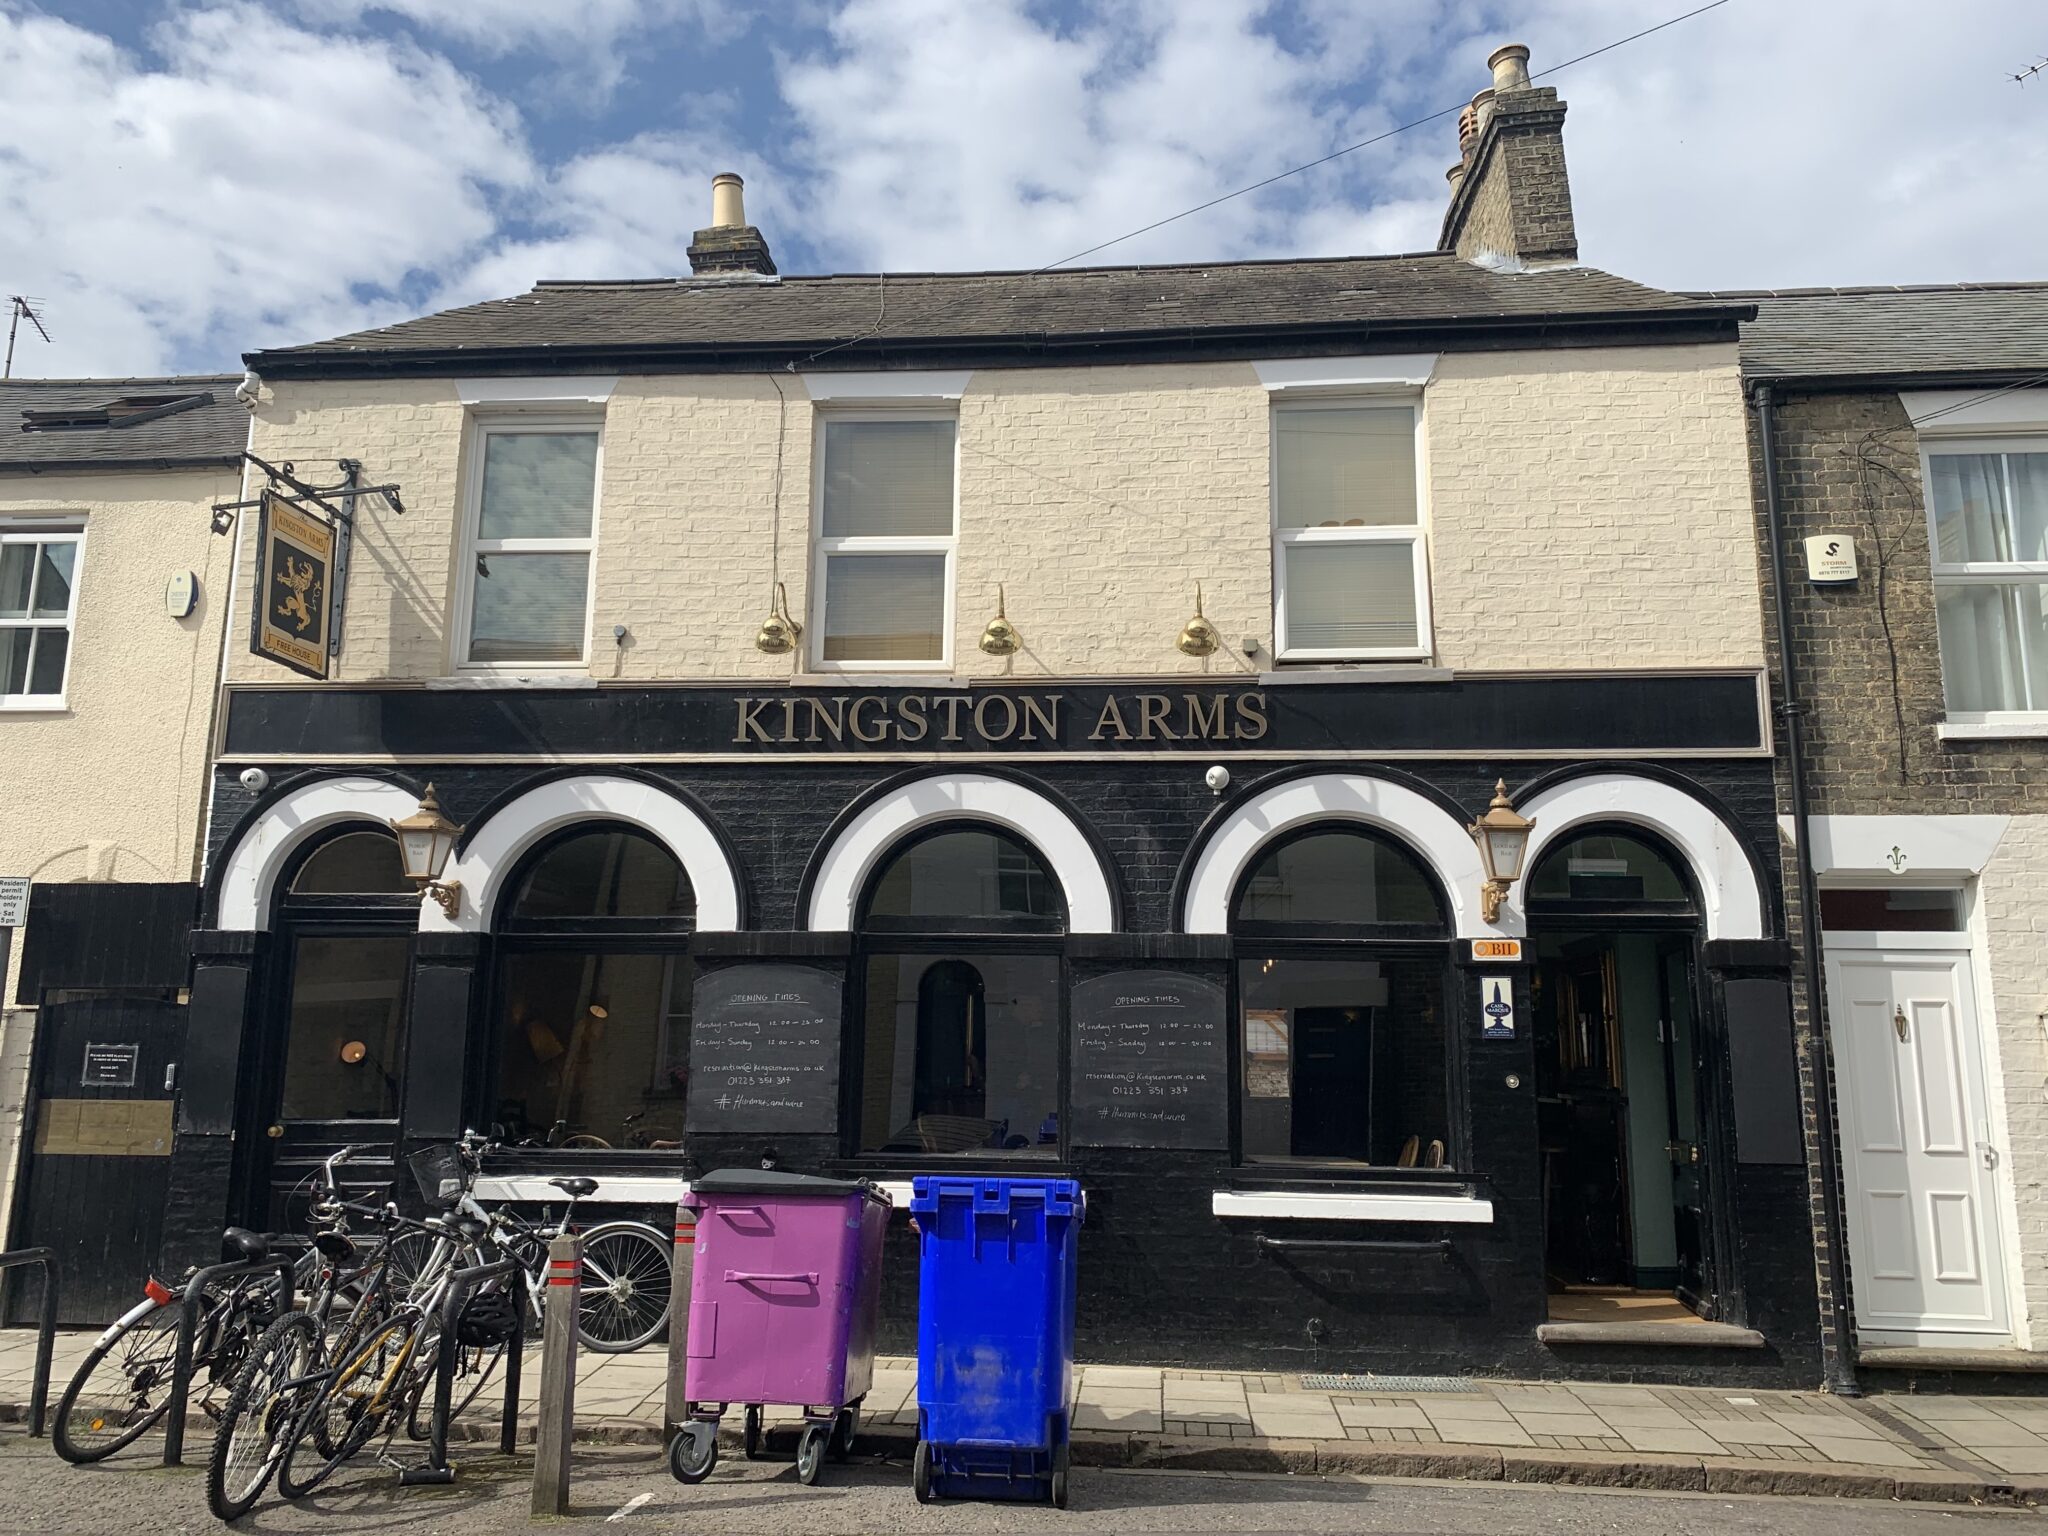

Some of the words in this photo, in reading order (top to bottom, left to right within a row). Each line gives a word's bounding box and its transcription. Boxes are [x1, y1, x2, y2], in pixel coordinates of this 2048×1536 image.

[279, 518, 307, 538] KINGSTON
[309, 531, 324, 547] ARMS
[277, 640, 291, 652] FREE
[292, 646, 310, 660] HOUSE
[732, 694, 1063, 743] KINGSTON
[1087, 692, 1268, 741] ARMS
[730, 993, 768, 1002] OPENING
[775, 993, 801, 1001] TIMES
[1115, 996, 1150, 1006] OPENING
[1155, 996, 1180, 1004] TIMES
[696, 1021, 722, 1033] Monday
[729, 1021, 761, 1034] Thursday
[1078, 1022, 1111, 1036] Monday
[1120, 1022, 1150, 1035] Thursday
[727, 1037, 752, 1051] Sunday
[1118, 1038, 1146, 1055] Sunday
[727, 1076, 755, 1086] 01223
[1112, 1087, 1142, 1095] 01223
[1148, 1087, 1164, 1096] 351
[1170, 1087, 1188, 1095] 387
